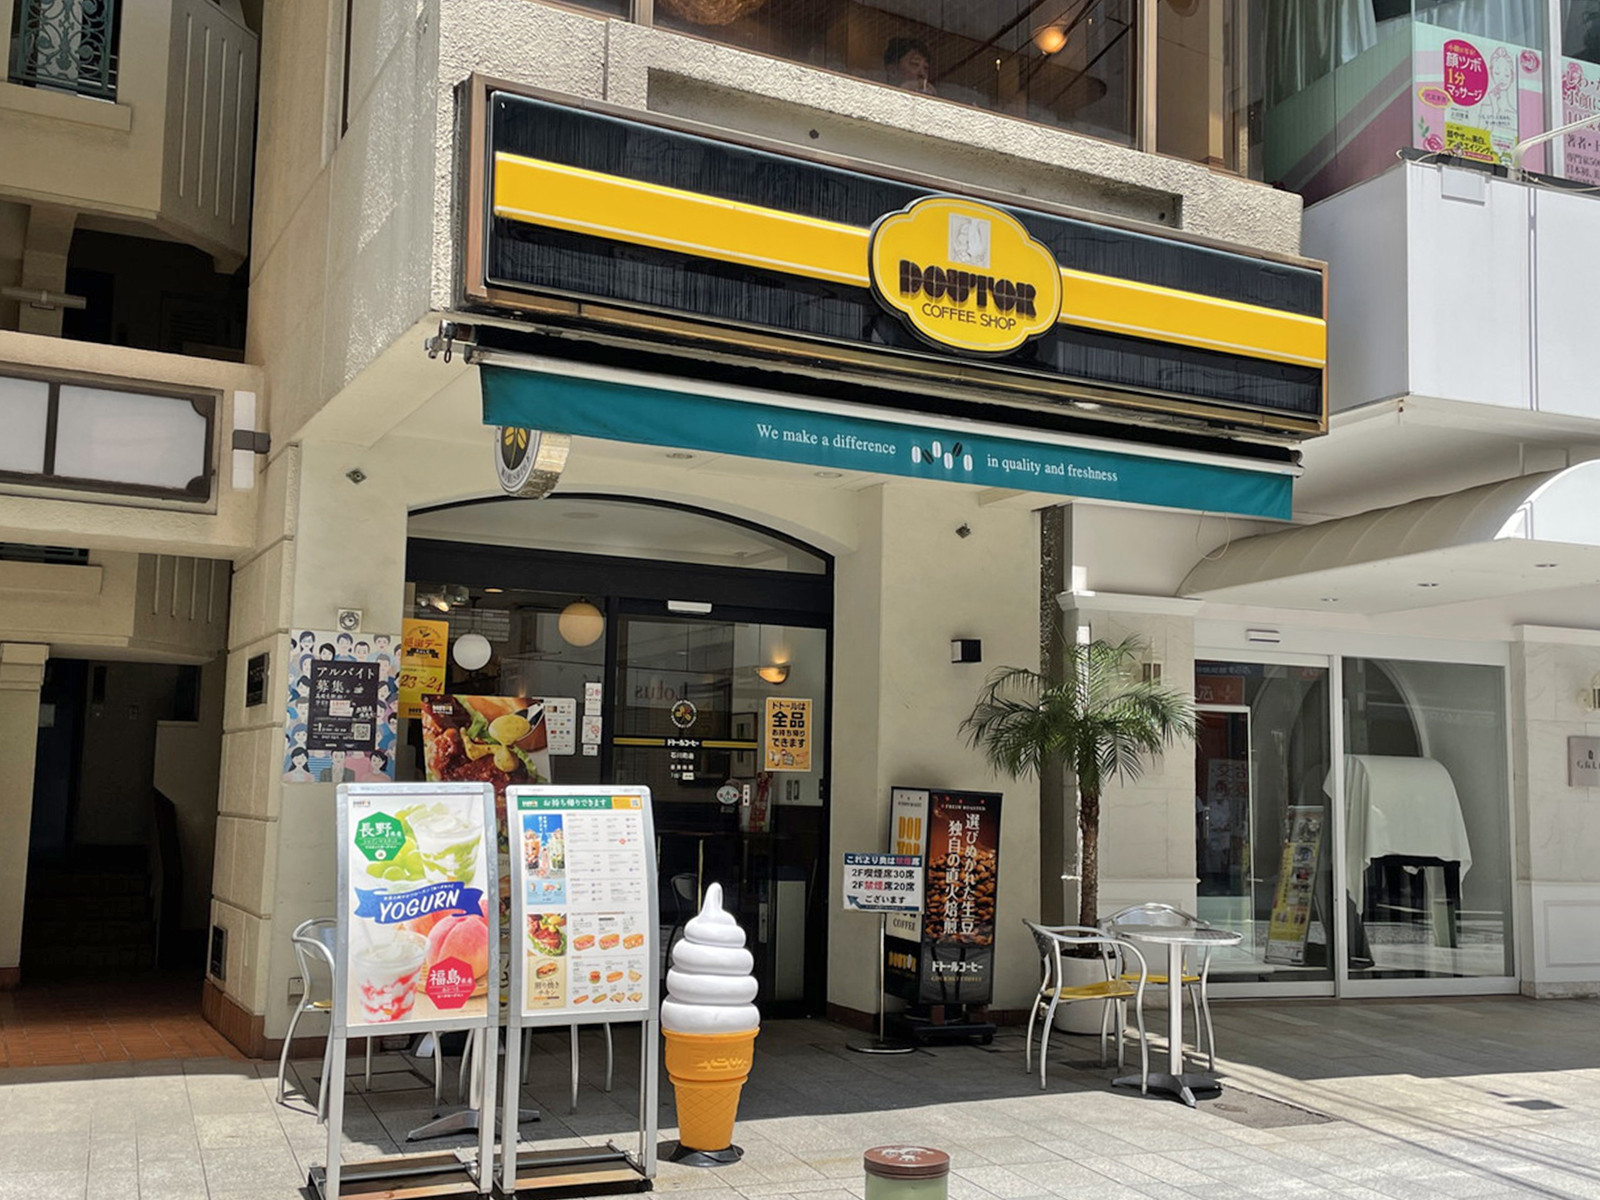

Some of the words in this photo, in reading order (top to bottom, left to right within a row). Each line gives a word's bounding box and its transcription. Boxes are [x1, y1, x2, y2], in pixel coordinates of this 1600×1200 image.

[1446, 52, 1482, 72] 顔ツボ
[1448, 68, 1466, 86] 1分
[1446, 84, 1482, 101] マッサージ
[899, 259, 1037, 318] DOUTOR
[921, 302, 977, 325] COFFEE
[980, 313, 1017, 331] SHOP
[756, 423, 779, 439] We
[782, 429, 819, 446] make
[821, 435, 830, 447] a
[832, 433, 897, 455] difference
[987, 454, 999, 468] in
[1001, 458, 1041, 476] quality
[1044, 462, 1065, 476] and
[1067, 463, 1118, 482] freshness
[316, 666, 375, 680] アルバイト
[772, 701, 806, 711] ドトールは
[772, 710, 805, 728] 全品
[771, 729, 806, 737] お持ち帰り
[771, 737, 806, 749] できます
[542, 797, 607, 808] お持ち帰りできます
[846, 854, 921, 866] これより奥は禁煙席
[851, 868, 915, 879] 2F喫煙席30席
[943, 819, 963, 935] 独自の直火焙煎
[961, 813, 980, 936] 選びぬかれた生豆
[852, 880, 915, 892] 2F禁煙席20席
[379, 888, 460, 923] YOGURN
[864, 894, 906, 905] ございます
[931, 960, 984, 973] ドトールコーヒー
